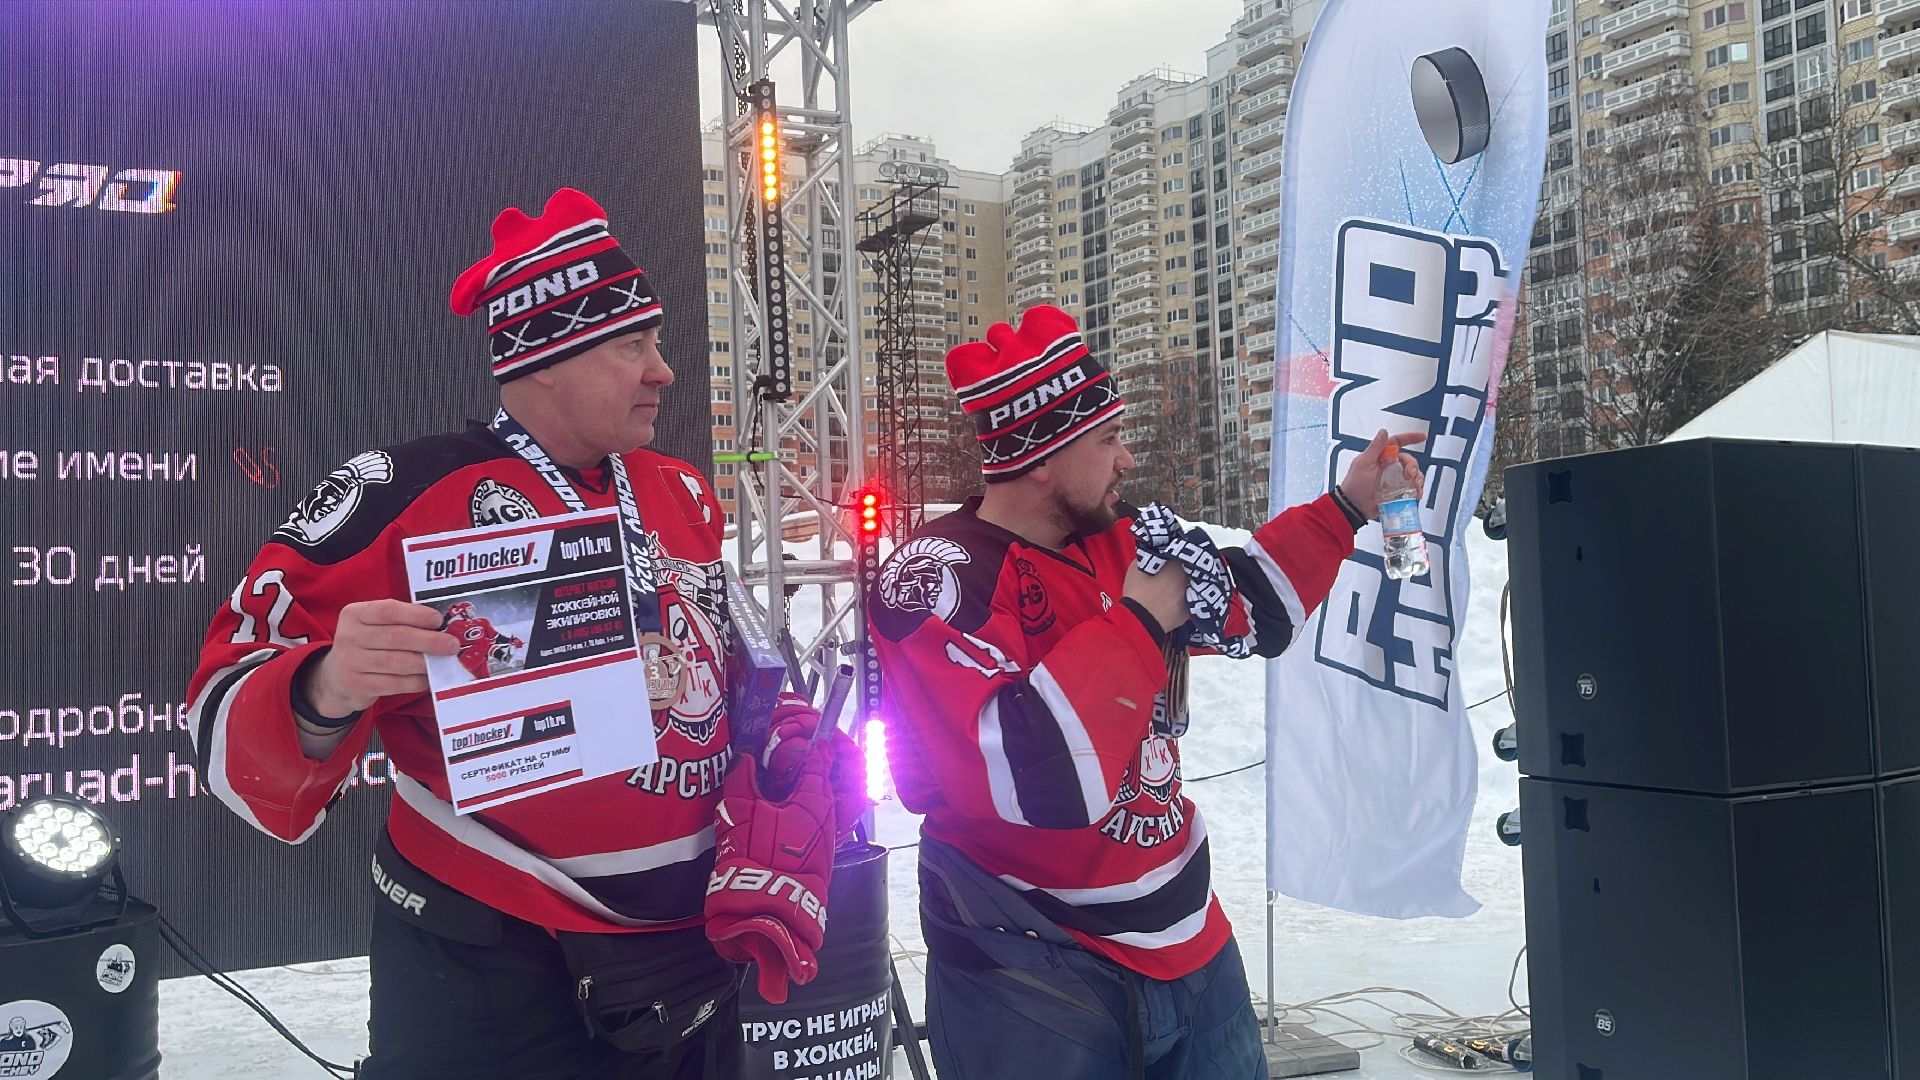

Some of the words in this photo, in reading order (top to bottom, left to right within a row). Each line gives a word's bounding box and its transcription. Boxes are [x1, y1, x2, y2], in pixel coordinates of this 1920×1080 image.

[0, 354, 59, 385] ая
[78, 354, 283, 394] доставка
[989, 365, 1087, 430] POND
[57, 449, 197, 481] имени
[560, 535, 612, 561] top1h.ru
[12, 546, 76, 585] 30
[95, 543, 205, 592] дней
[230, 569, 309, 649] 12
[546, 606, 621, 629] ЭКИПИРОВКИ
[551, 590, 619, 615] ХОККЕЙНОЙ
[461, 757, 523, 780] СЕРТИФИКАТ
[524, 754, 538, 763] НА
[540, 745, 571, 760] СУММУ
[485, 770, 508, 783] 5000
[509, 760, 545, 777] РУБЛЕЙ
[626, 743, 733, 798] АРСЕН
[741, 1019, 802, 1042] ТРУС
[806, 1013, 836, 1036] НЕ
[839, 996, 888, 1030] ИГРАЕТ
[1597, 1018, 1612, 1031] B5
[773, 1050, 789, 1070] В
[794, 1027, 878, 1068] ХОККЕЙ,
